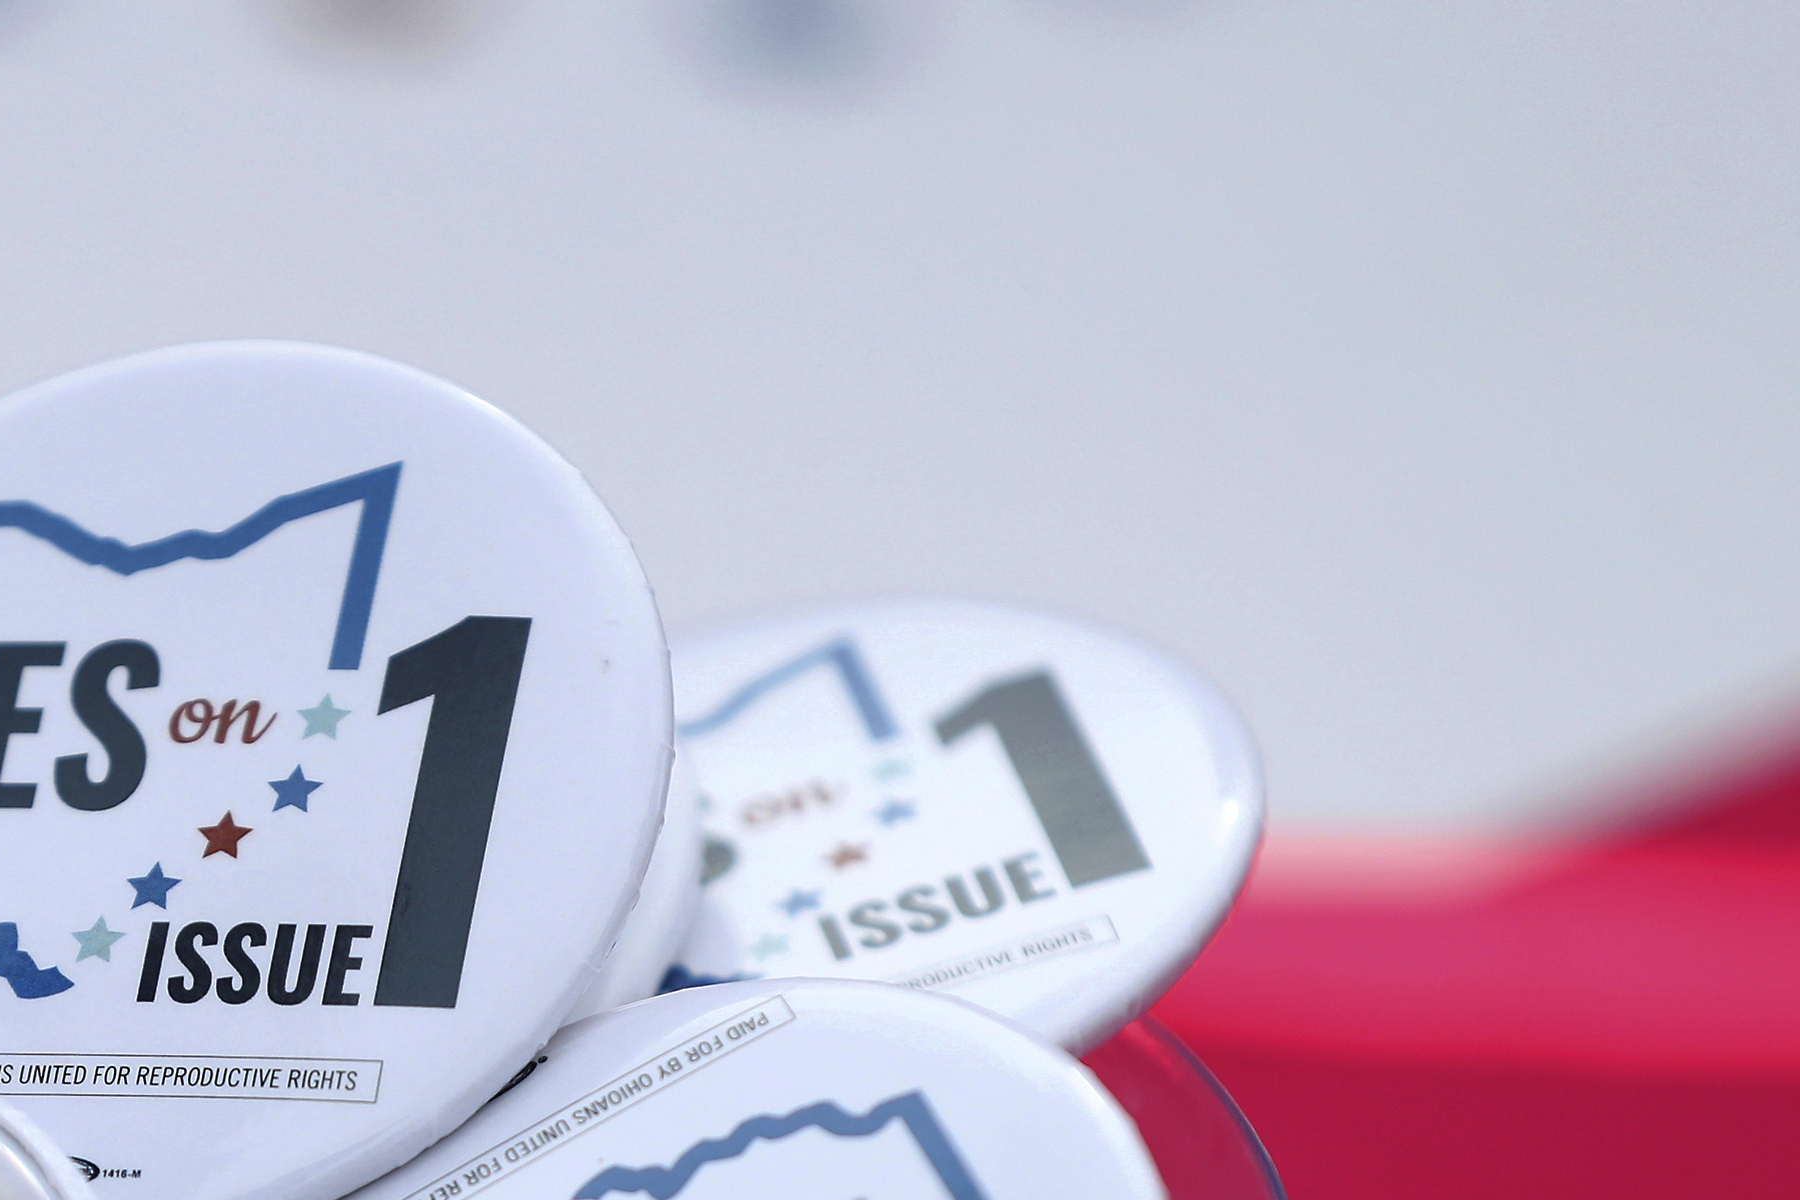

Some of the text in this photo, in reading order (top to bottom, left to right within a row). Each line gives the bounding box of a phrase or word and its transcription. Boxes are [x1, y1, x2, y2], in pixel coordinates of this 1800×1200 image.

[168, 697, 278, 745] on
[136, 614, 533, 1009] ISSUE 1
[816, 661, 1154, 962] ISSUE 1
[1020, 926, 1094, 958] RIGHTS
[726, 1011, 770, 1041] PAID
[684, 1035, 724, 1063] FOR
[18, 1063, 86, 1086] UNITED
[92, 1065, 131, 1086] FOR
[135, 1066, 281, 1089] REPRODUCTIVE
[286, 1068, 359, 1092] RIGHTS
[656, 1056, 683, 1081] BY
[572, 1071, 654, 1126] OHIOANS
[503, 1117, 571, 1164] UNITED
[102, 1168, 142, 1179] 1416-M
[463, 1156, 503, 1187] FOR
